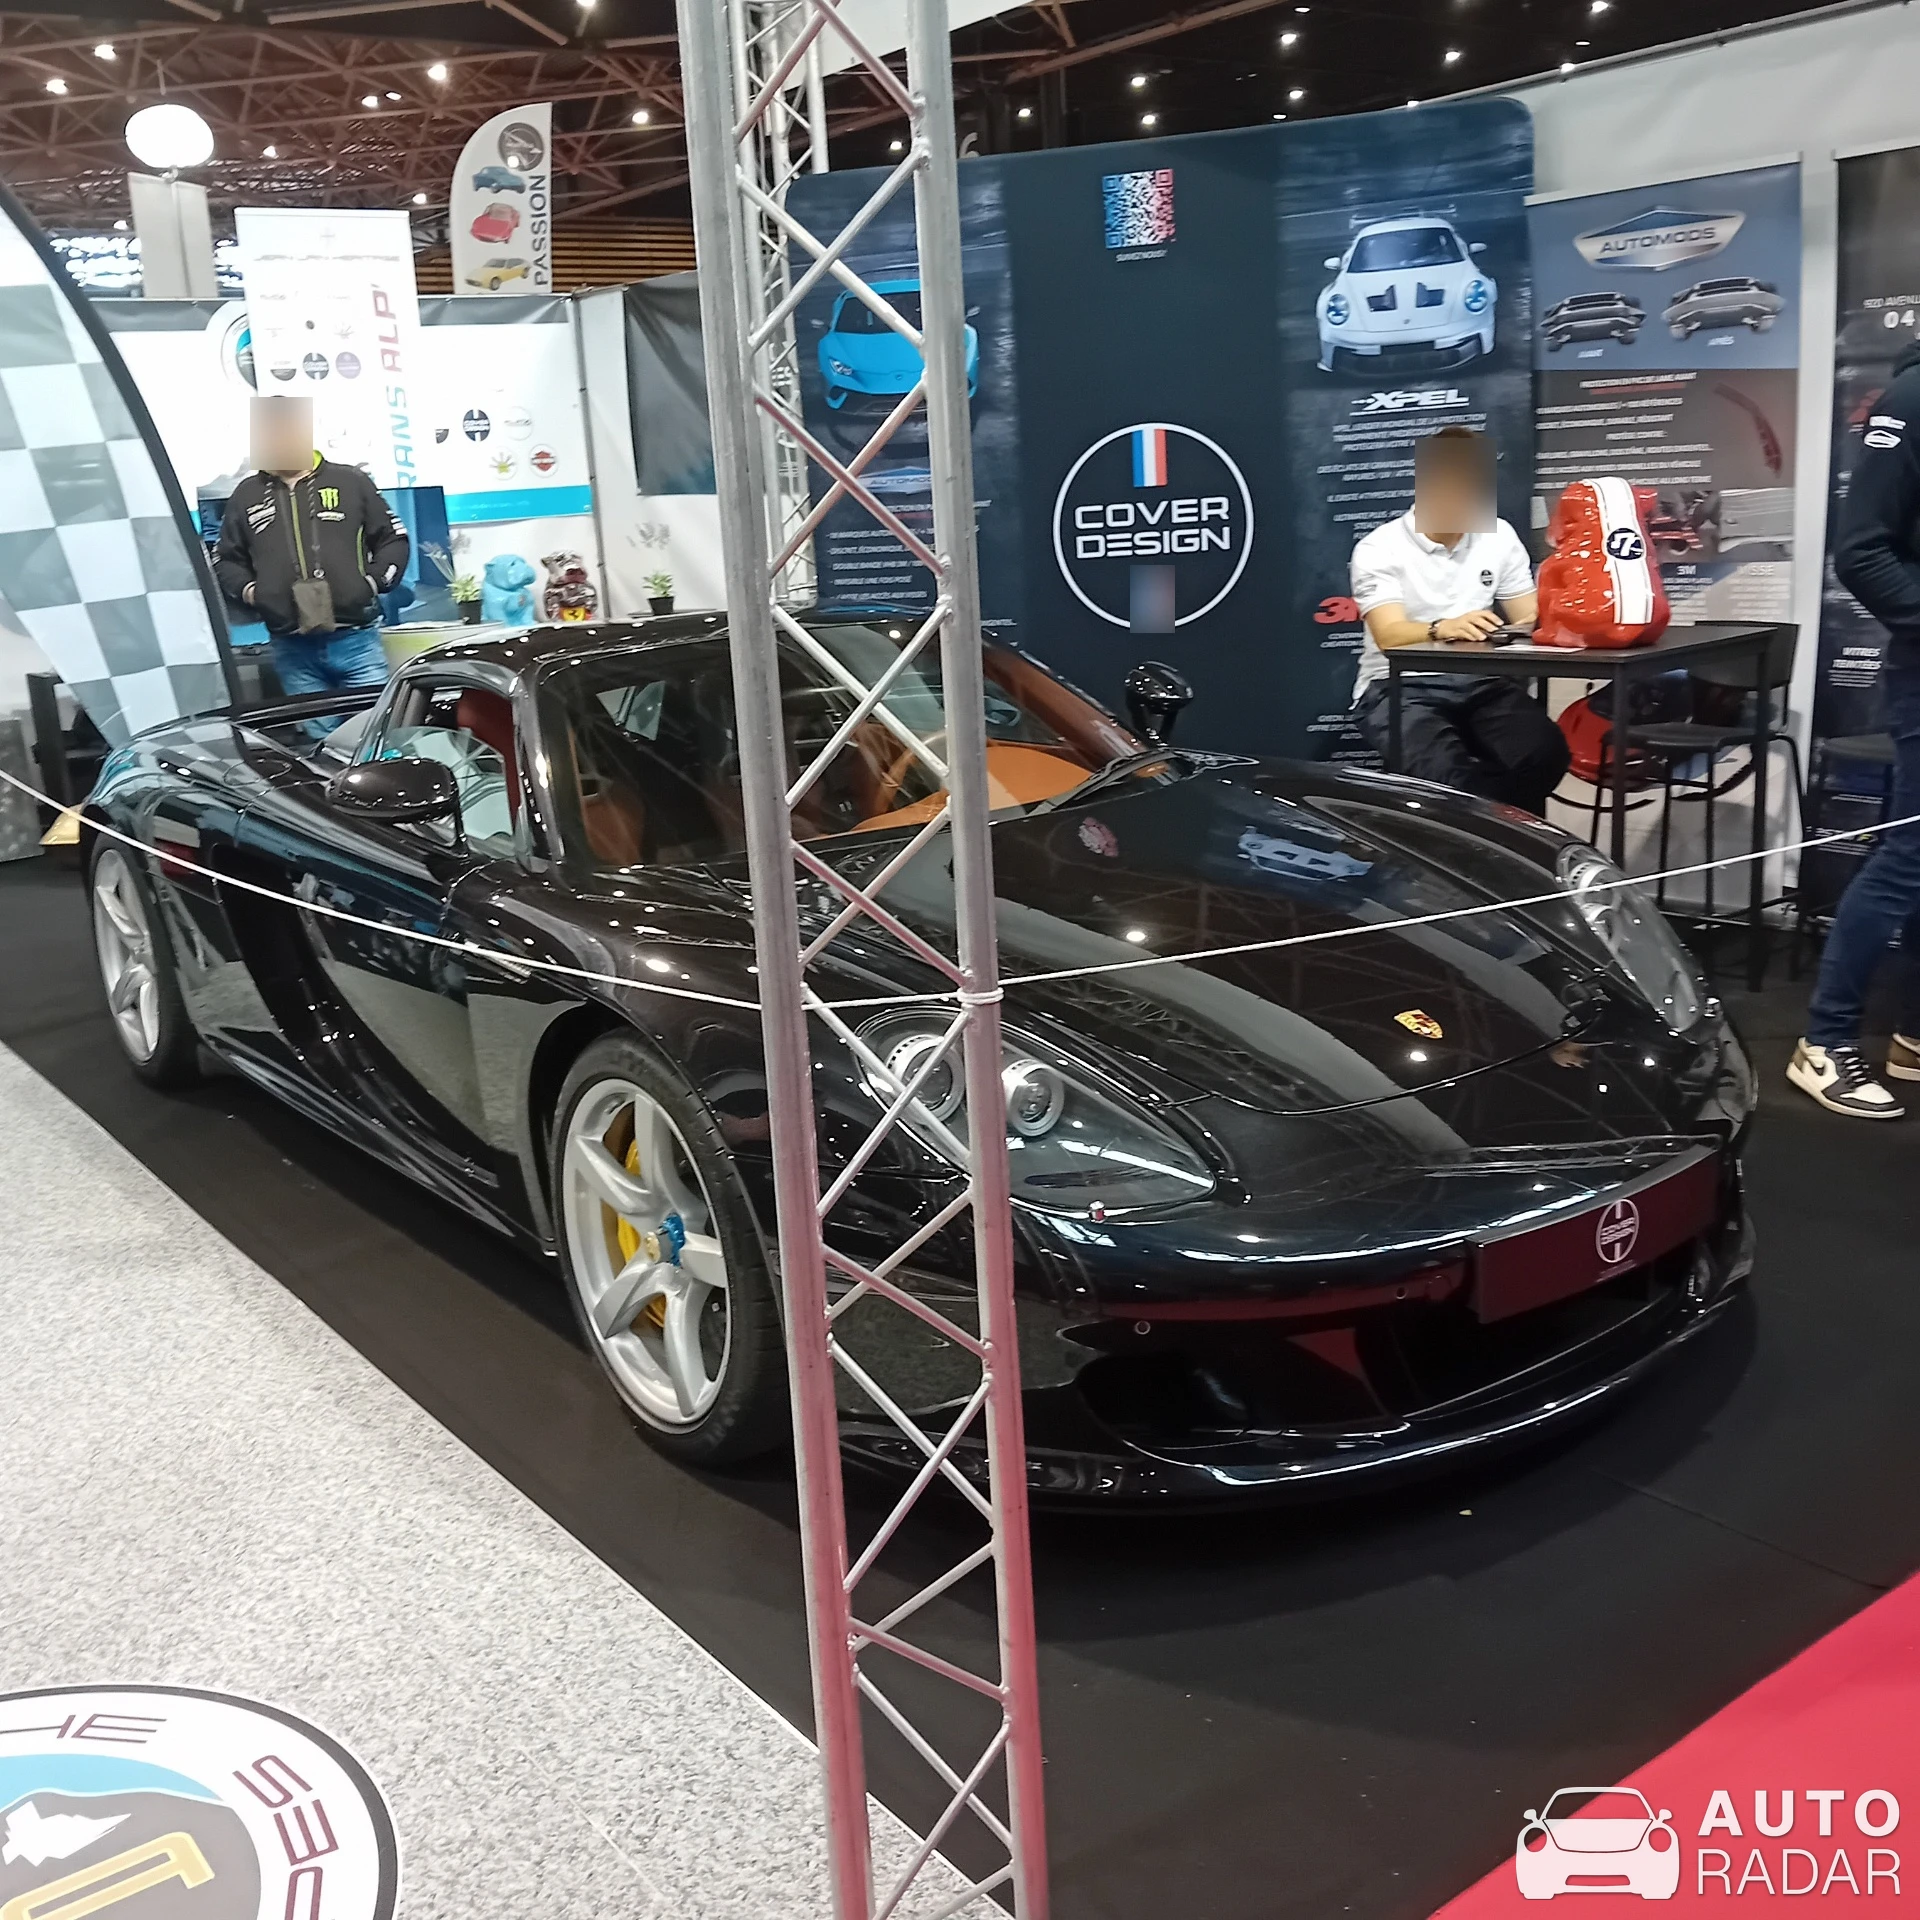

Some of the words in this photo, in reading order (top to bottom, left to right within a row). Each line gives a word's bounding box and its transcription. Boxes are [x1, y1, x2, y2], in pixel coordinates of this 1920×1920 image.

[529, 175, 549, 286] PASSION
[1600, 227, 1716, 253] AUTOMODS
[1884, 310, 1915, 328] 04
[1362, 389, 1469, 411] XPEL
[1075, 496, 1230, 530] COVER
[1076, 526, 1230, 559] DESIGN
[1677, 565, 1696, 576] 3M
